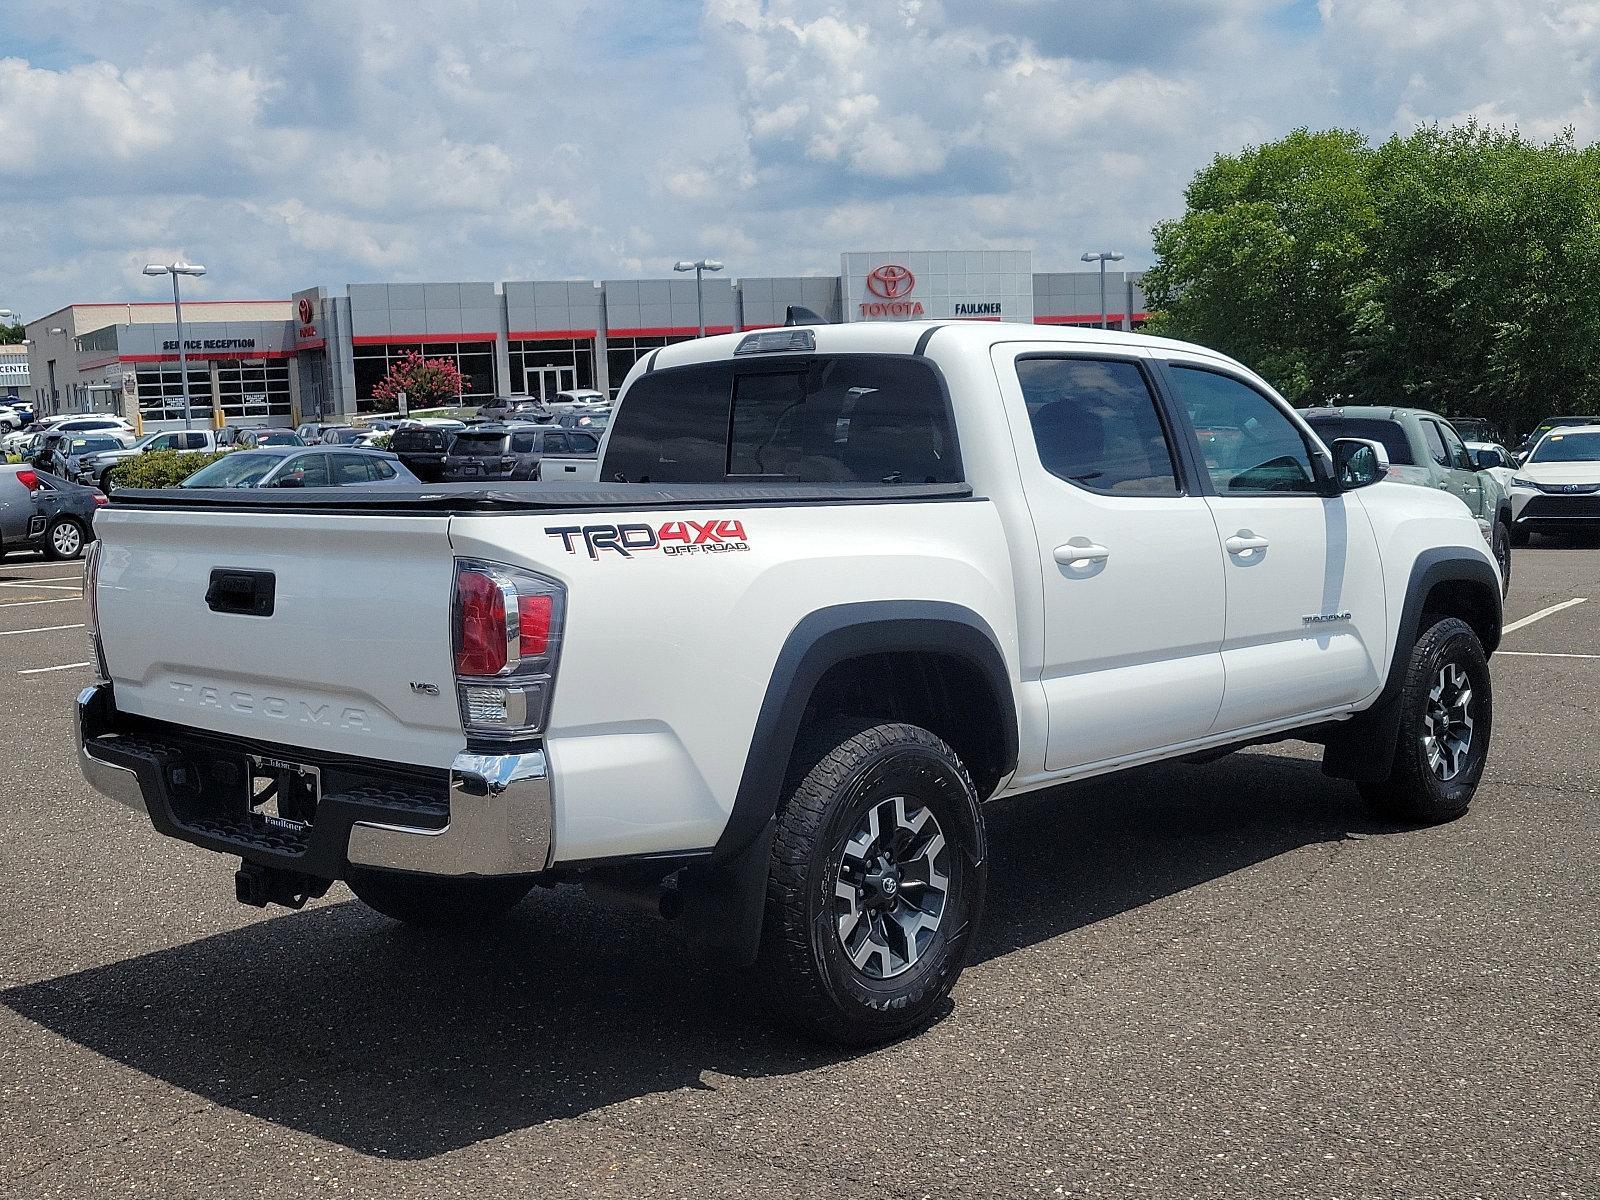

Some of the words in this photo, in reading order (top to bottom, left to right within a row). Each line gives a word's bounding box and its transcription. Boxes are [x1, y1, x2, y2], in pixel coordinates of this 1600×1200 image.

[858, 301, 925, 316] TOYOTA
[955, 302, 1002, 315] FAULKNER
[203, 338, 256, 349] RECEPTION
[544, 523, 660, 561] TRD
[662, 544, 698, 556] OFF
[701, 542, 750, 555] ROAD
[409, 680, 441, 696] V6
[169, 681, 372, 732] TACOMA
[265, 816, 304, 832] Faulkner
